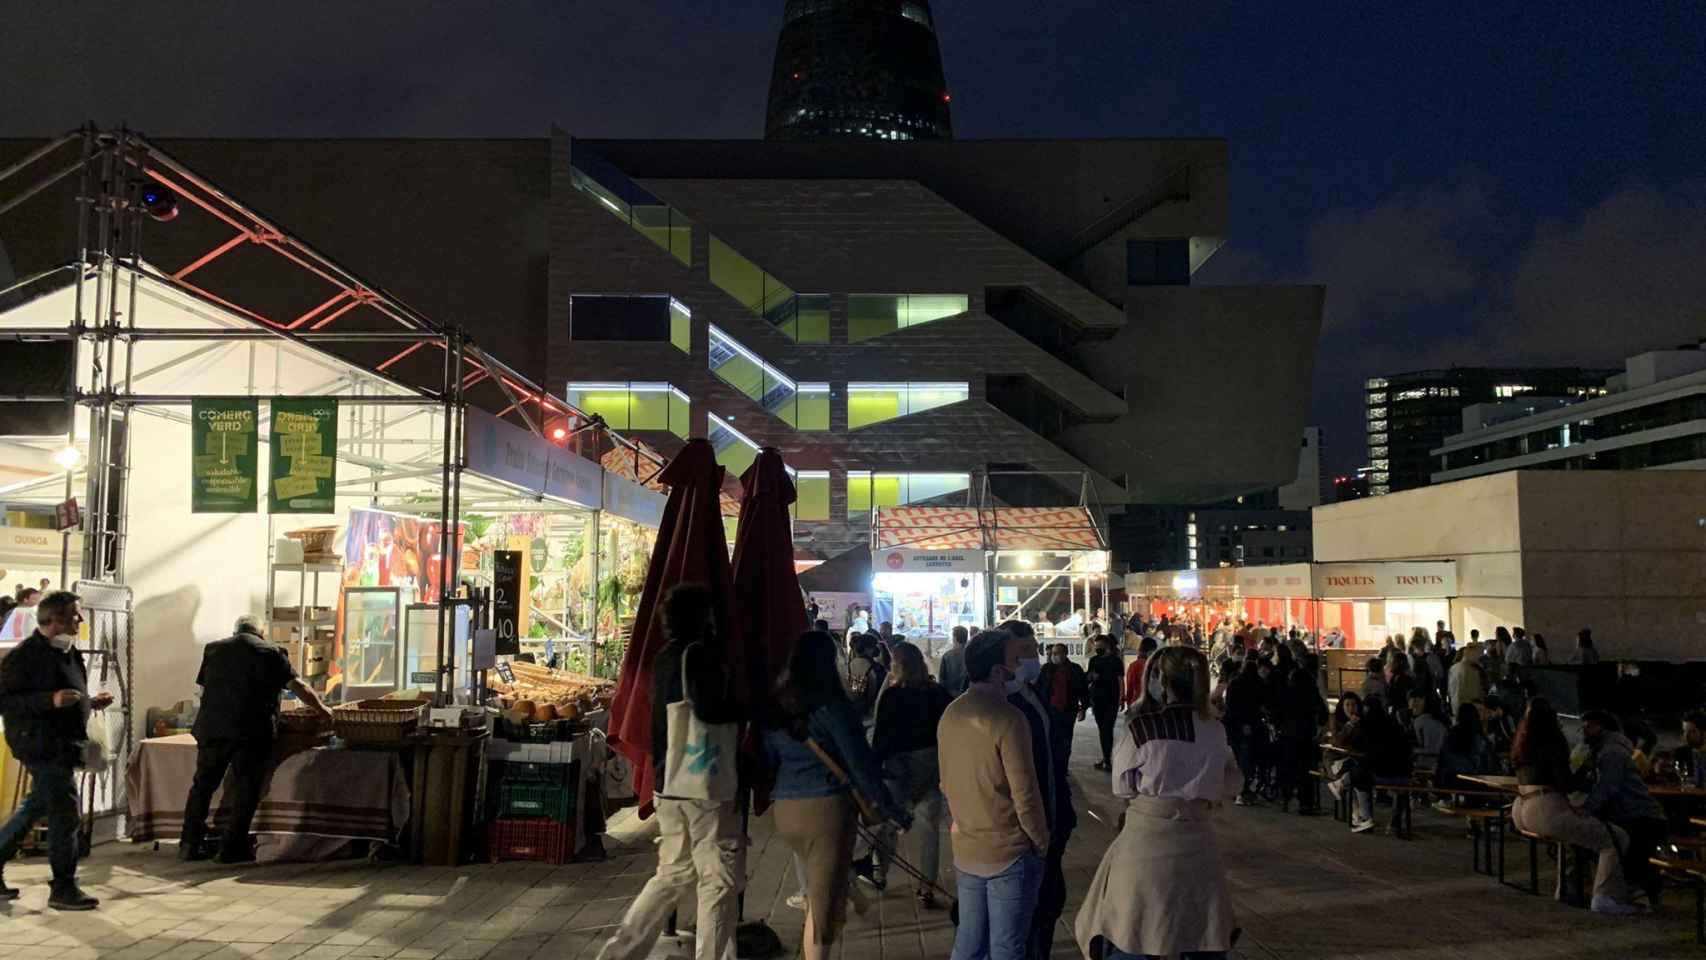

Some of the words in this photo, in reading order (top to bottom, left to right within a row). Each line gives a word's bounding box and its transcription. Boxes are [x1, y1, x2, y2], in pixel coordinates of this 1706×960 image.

[208, 421, 242, 432] VERD
[15, 535, 48, 545] QUINOA
[1327, 575, 1375, 586] TIQUETS
[1395, 575, 1444, 585] TIQUETS
[496, 588, 508, 604] 2
